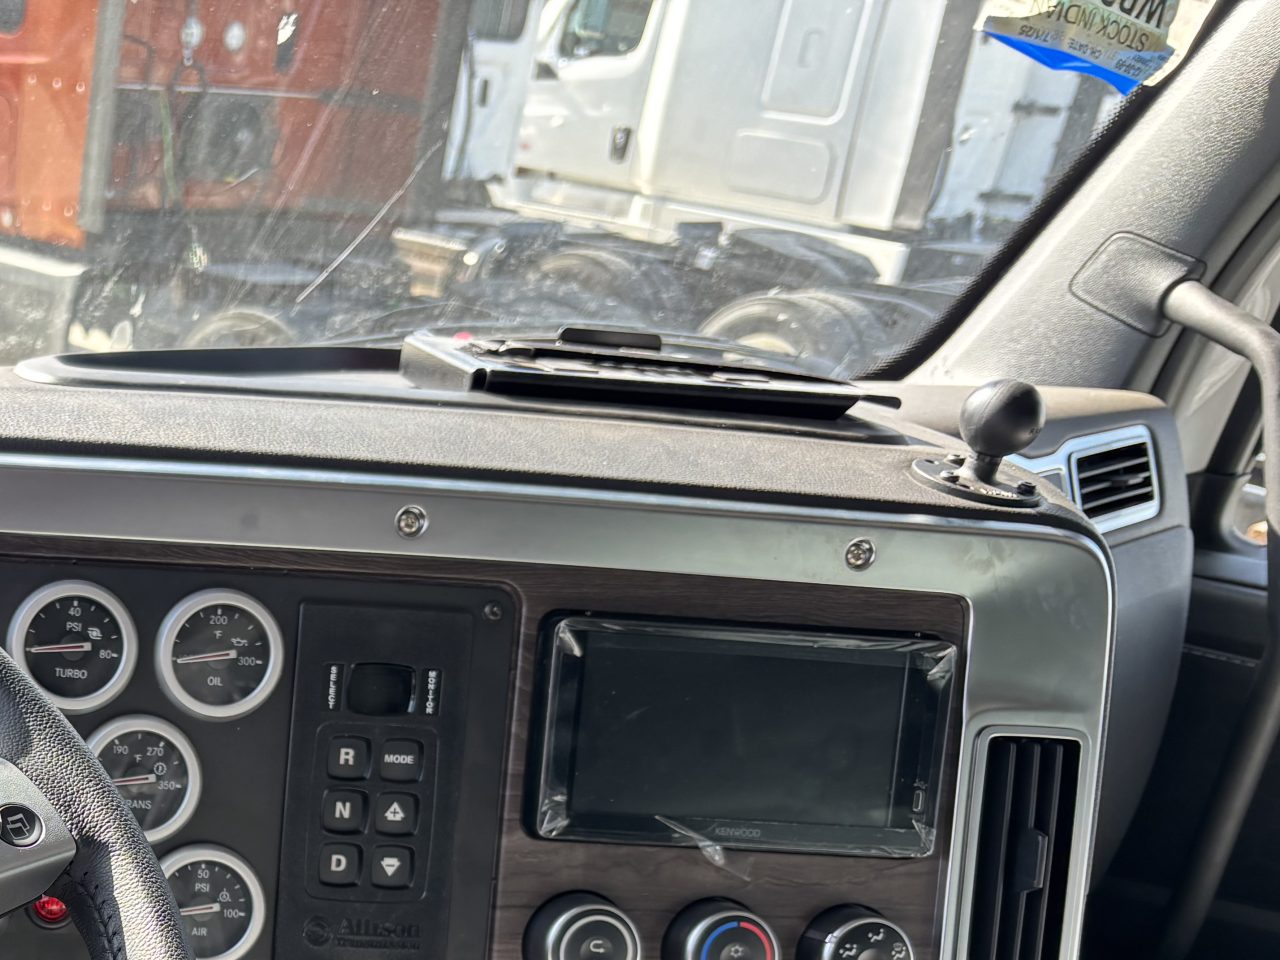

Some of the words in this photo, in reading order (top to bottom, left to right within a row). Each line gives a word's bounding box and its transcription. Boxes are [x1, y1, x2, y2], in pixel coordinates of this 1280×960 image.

[1096, 13, 1149, 52] STOCK
[68, 607, 82, 617] 40
[209, 615, 228, 625] 200
[66, 621, 82, 632] PSI
[99, 649, 112, 659] 80
[238, 656, 256, 666] 300
[55, 667, 88, 679] TURBO
[207, 676, 223, 687] OIL
[328, 665, 338, 710] SELECT
[113, 745, 129, 755] 190
[146, 747, 164, 757] 270
[339, 748, 355, 765] R
[384, 754, 415, 765] MODE
[158, 781, 175, 790] 350
[335, 801, 351, 819] N
[330, 854, 347, 872] D
[197, 870, 210, 879] 50
[195, 883, 210, 892] PSI
[223, 909, 239, 918] 100
[191, 927, 207, 937] AIR
